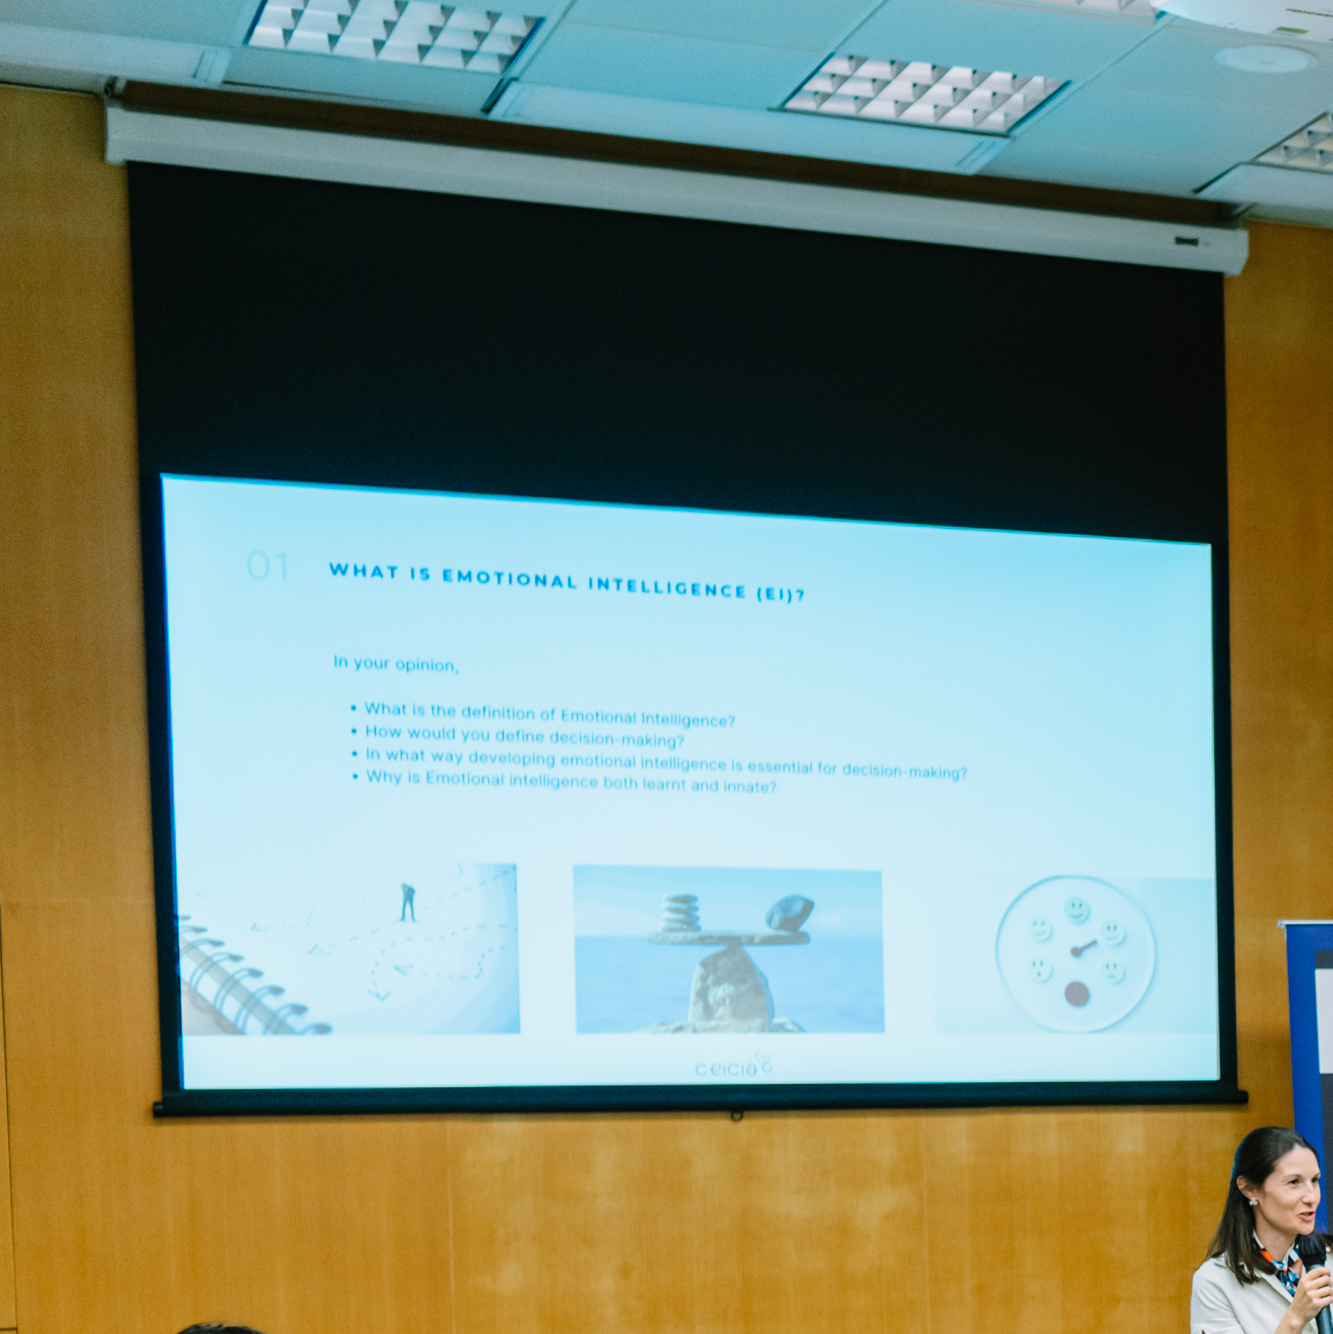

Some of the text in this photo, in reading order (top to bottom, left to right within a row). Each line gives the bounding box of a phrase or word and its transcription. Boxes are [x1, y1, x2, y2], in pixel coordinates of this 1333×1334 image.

[247, 549, 287, 582] 01
[329, 561, 805, 604] WHAT IS EMOTIONAL INTELLIGENCE (EI)?
[334, 654, 459, 675] In your opinion,
[365, 701, 735, 730] What is the definition of Emotional Intelligence?
[365, 724, 685, 751] How would you define decision-making?
[366, 747, 968, 783] In what way developing emotional intelligence is essential for decision-making?
[366, 769, 777, 794] Why is Emotional intelligence both learnt and innate?
